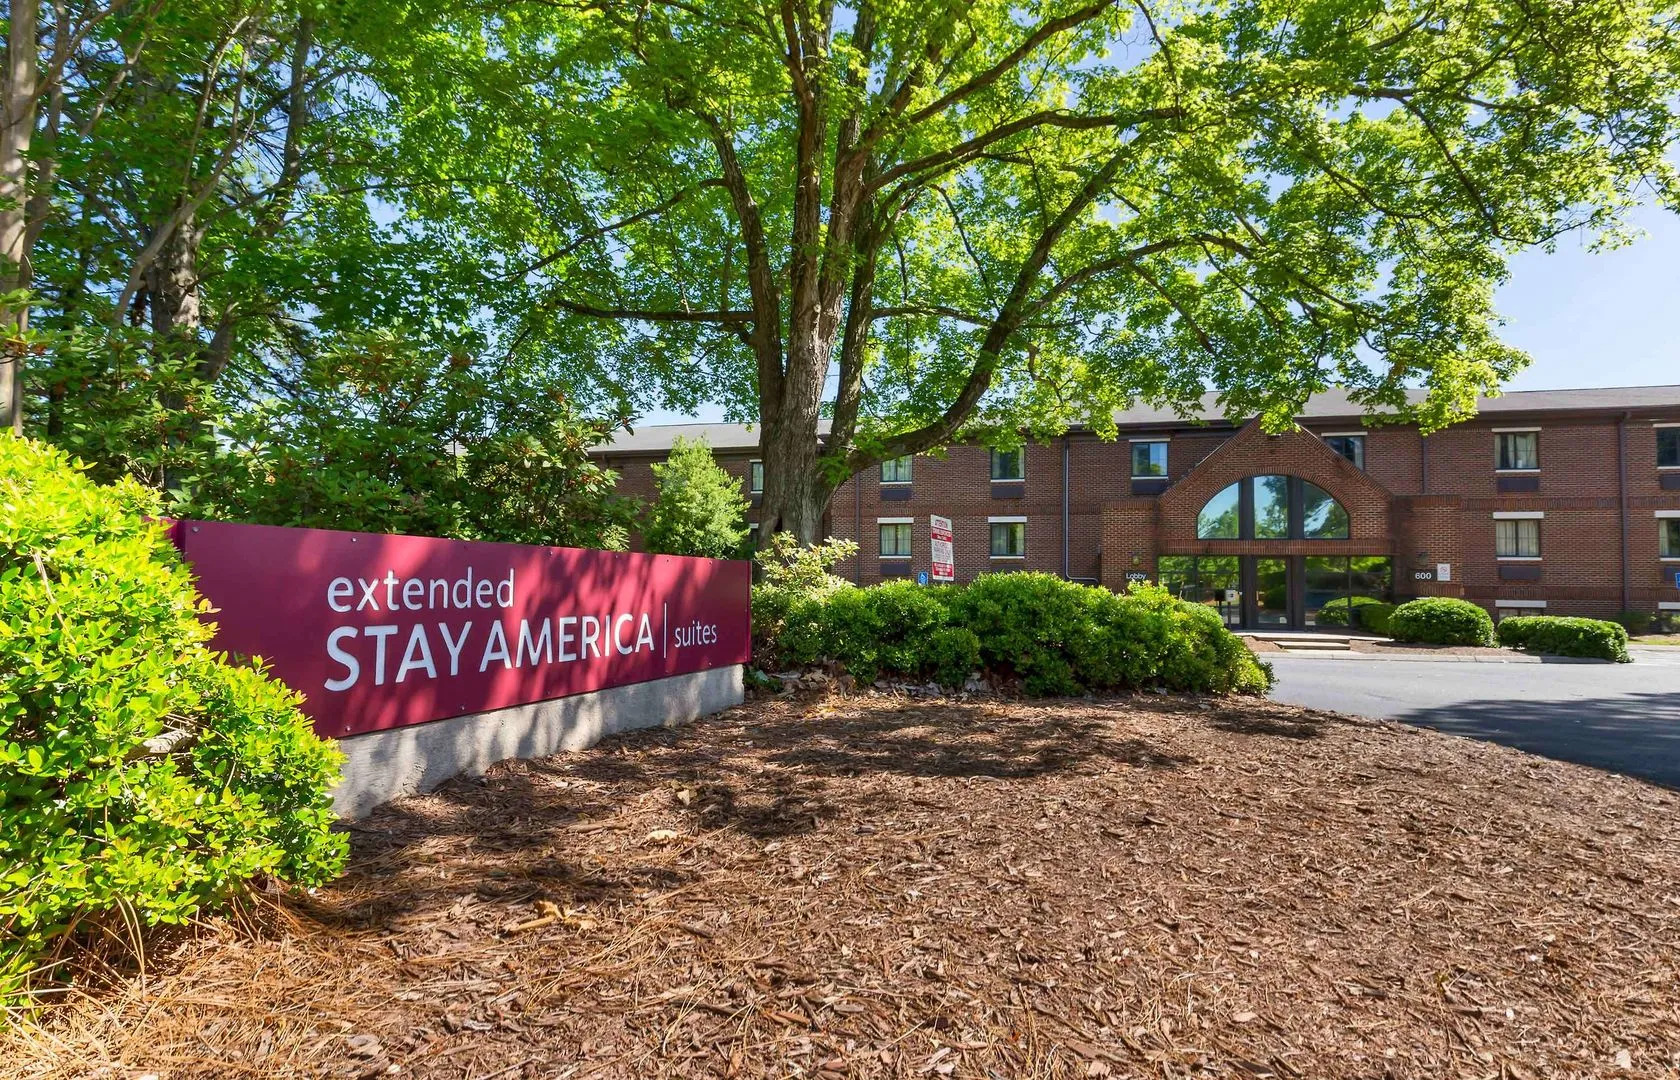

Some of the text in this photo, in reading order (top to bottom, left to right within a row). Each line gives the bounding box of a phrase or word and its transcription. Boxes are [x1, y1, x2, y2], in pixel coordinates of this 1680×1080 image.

[326, 566, 515, 613] extended
[1125, 572, 1147, 580] Lobby
[1415, 572, 1432, 580] 600
[323, 612, 718, 693] STAY AMERICA suites
